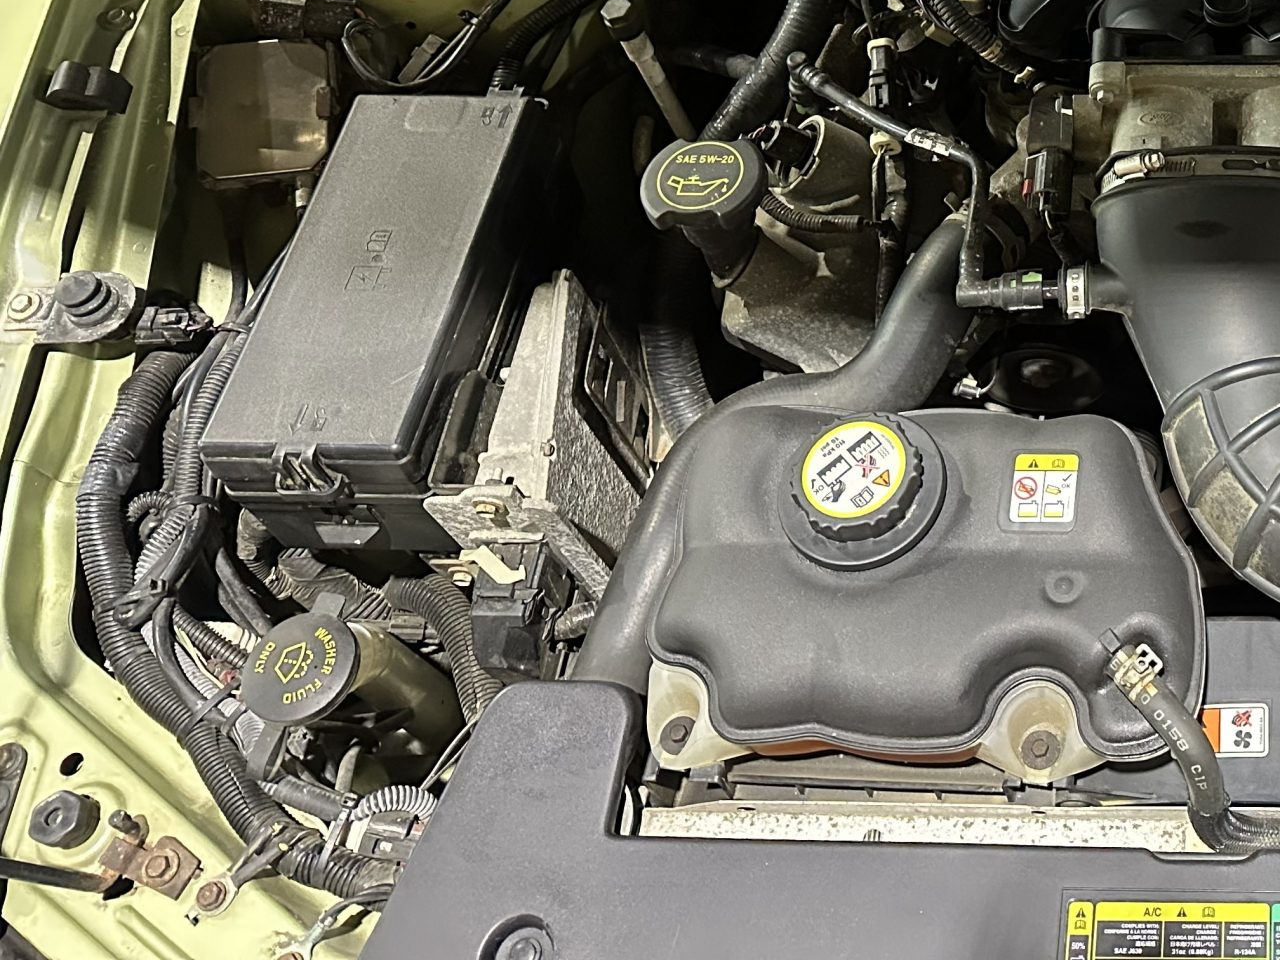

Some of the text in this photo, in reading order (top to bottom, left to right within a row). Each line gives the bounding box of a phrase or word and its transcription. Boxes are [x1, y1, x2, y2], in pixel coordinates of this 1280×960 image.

[676, 154, 735, 164] SAE 5W-20
[822, 447, 836, 458] kPa
[813, 484, 824, 495] OK
[314, 627, 337, 675] WASHER
[254, 641, 276, 674] ONLY
[282, 678, 322, 704] FLUID
[1153, 709, 1190, 752] 0158
[1190, 764, 1208, 791] CIP
[1143, 907, 1163, 917] A/C
[1071, 942, 1086, 950] 50%
[1234, 948, 1257, 956] R-134A
